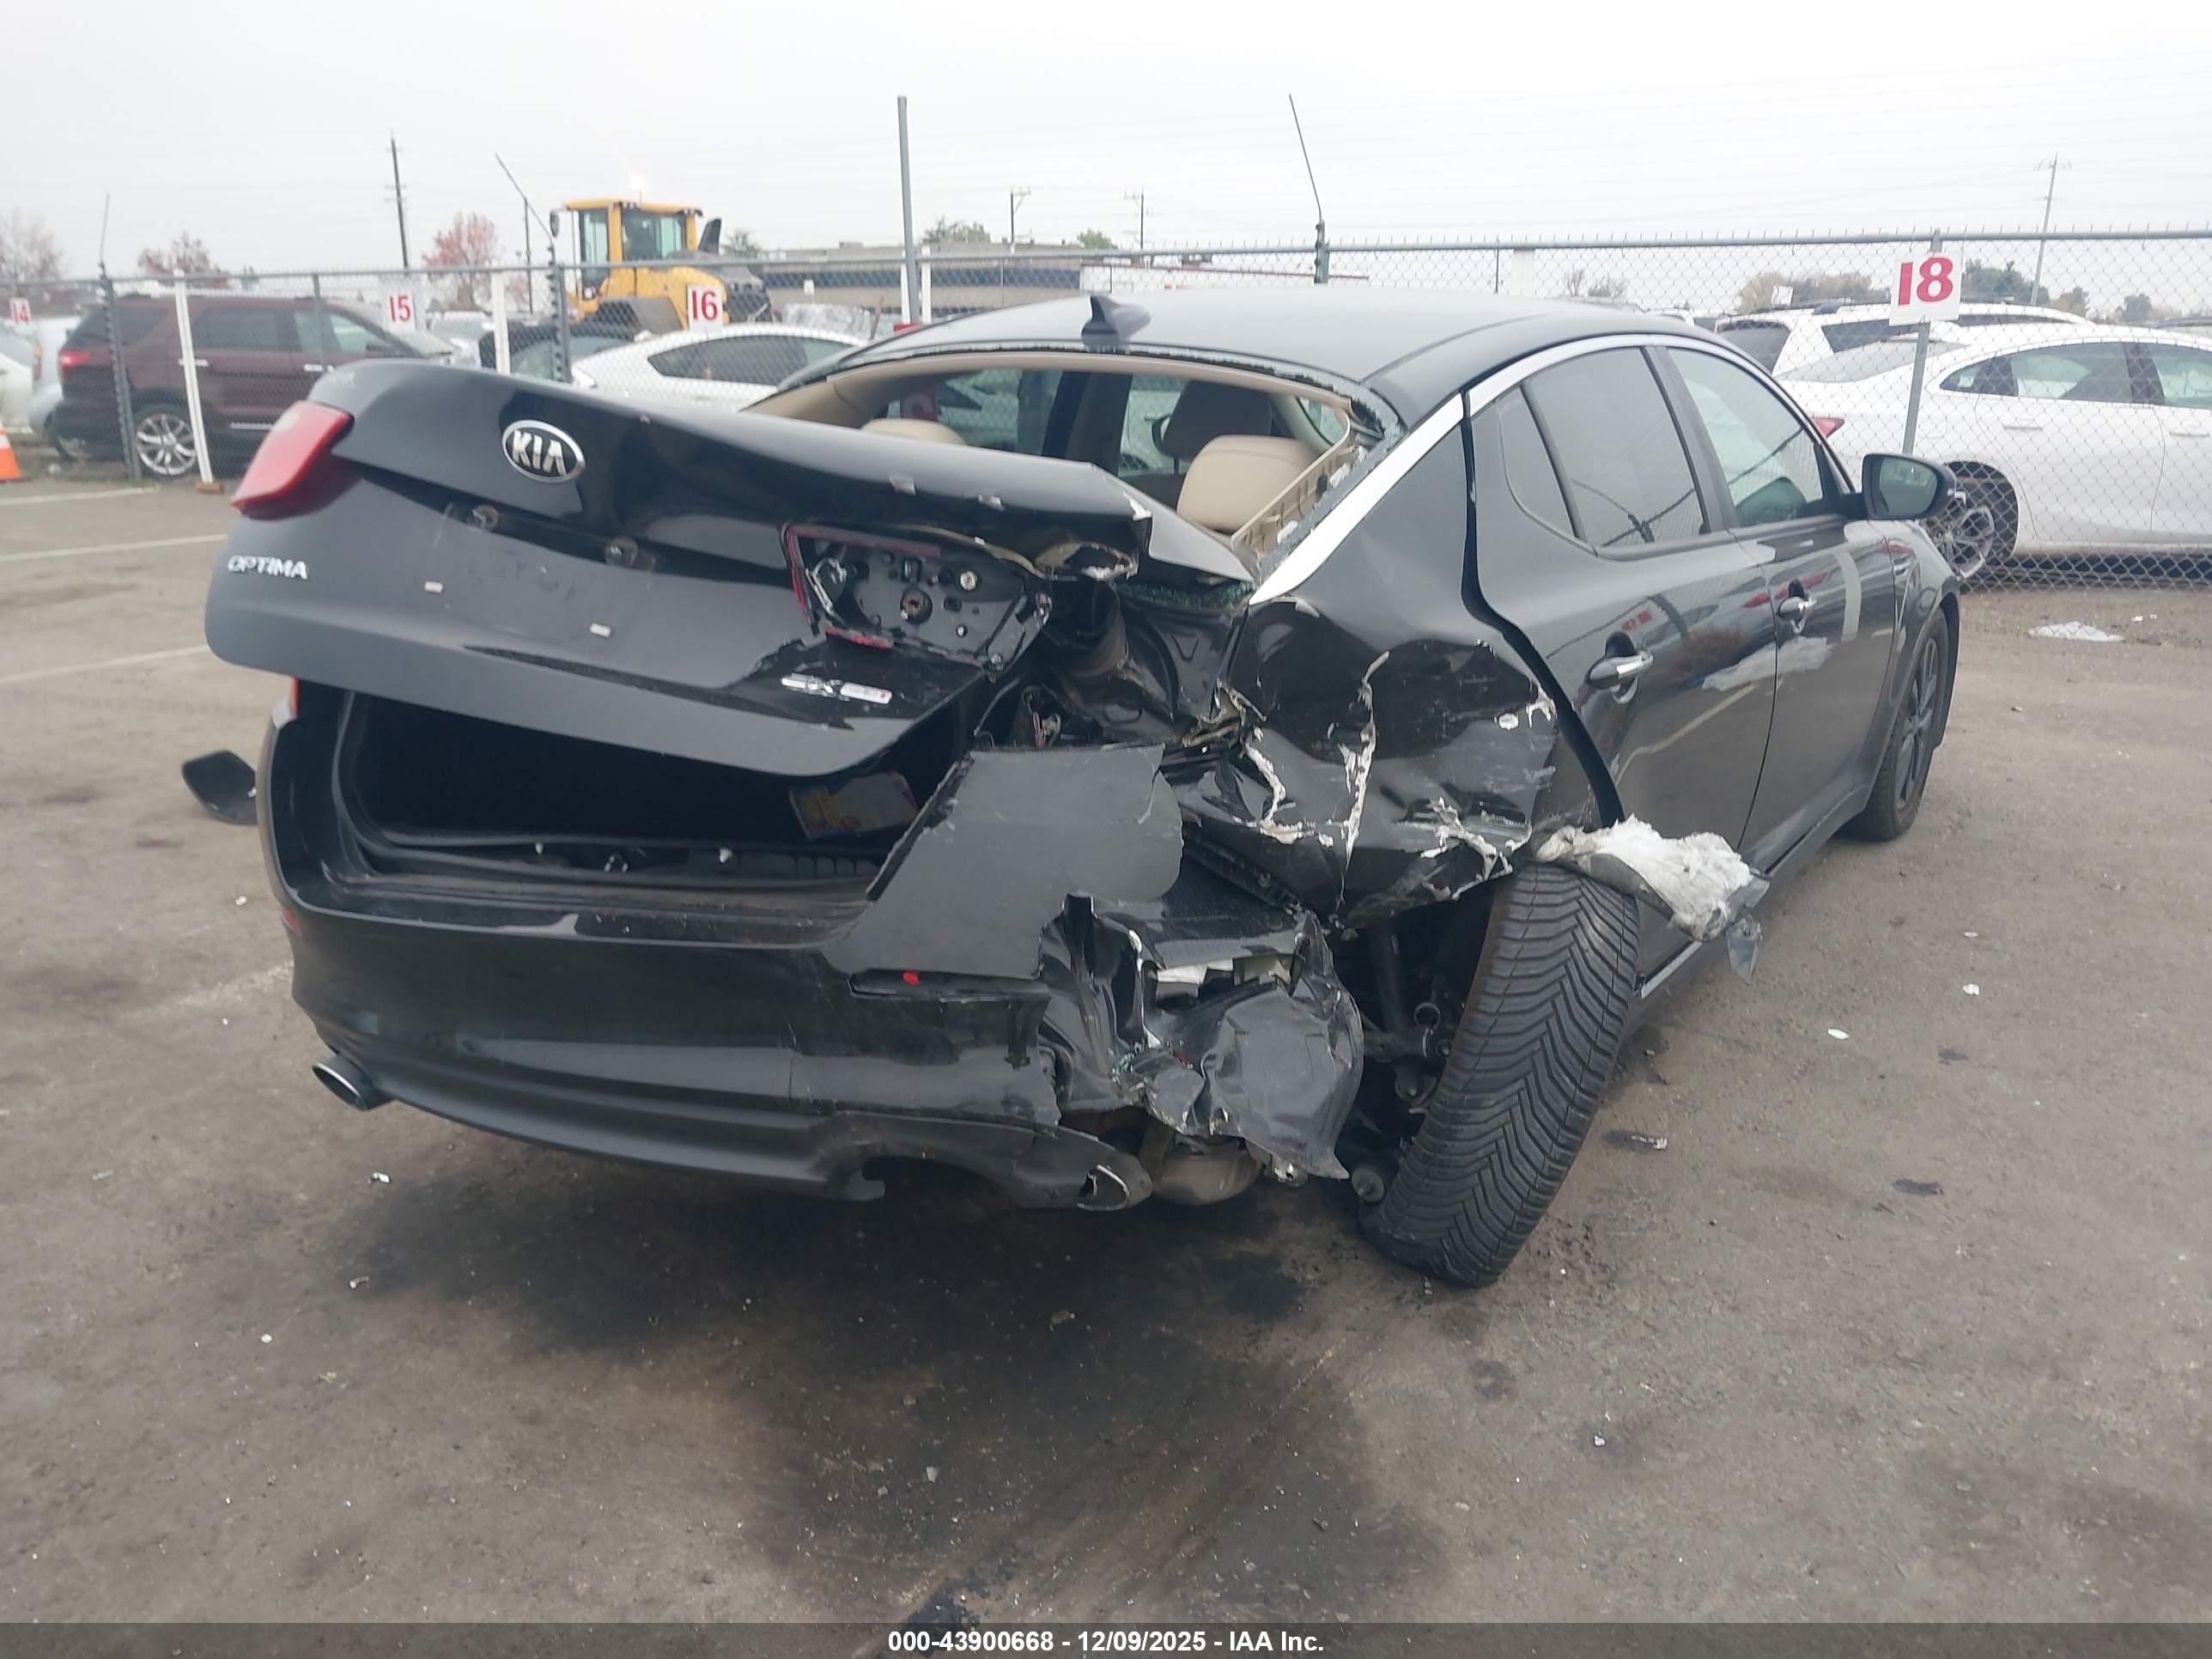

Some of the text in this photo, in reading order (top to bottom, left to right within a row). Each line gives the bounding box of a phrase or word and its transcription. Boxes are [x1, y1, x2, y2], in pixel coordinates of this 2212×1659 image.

[1898, 257, 1954, 306] 18
[12, 301, 29, 324] 14
[389, 295, 411, 322] 15
[691, 290, 718, 320] 16
[513, 429, 567, 476] KIA
[228, 556, 307, 580] OPTIMA
